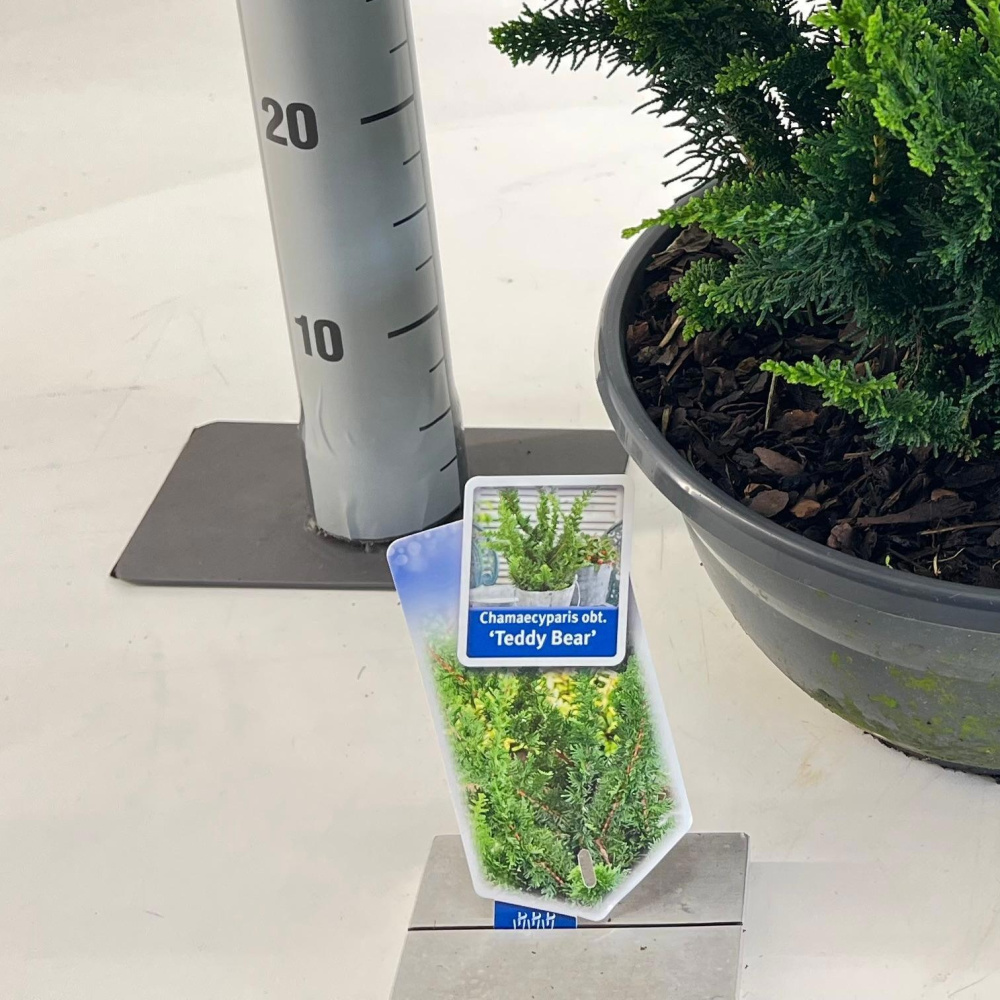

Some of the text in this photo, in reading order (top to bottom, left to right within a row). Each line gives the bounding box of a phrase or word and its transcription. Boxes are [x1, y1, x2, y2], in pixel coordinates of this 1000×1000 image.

[261, 96, 319, 150] 20
[294, 314, 344, 363] 10
[479, 610, 607, 627] Chamaecyparis obt.
